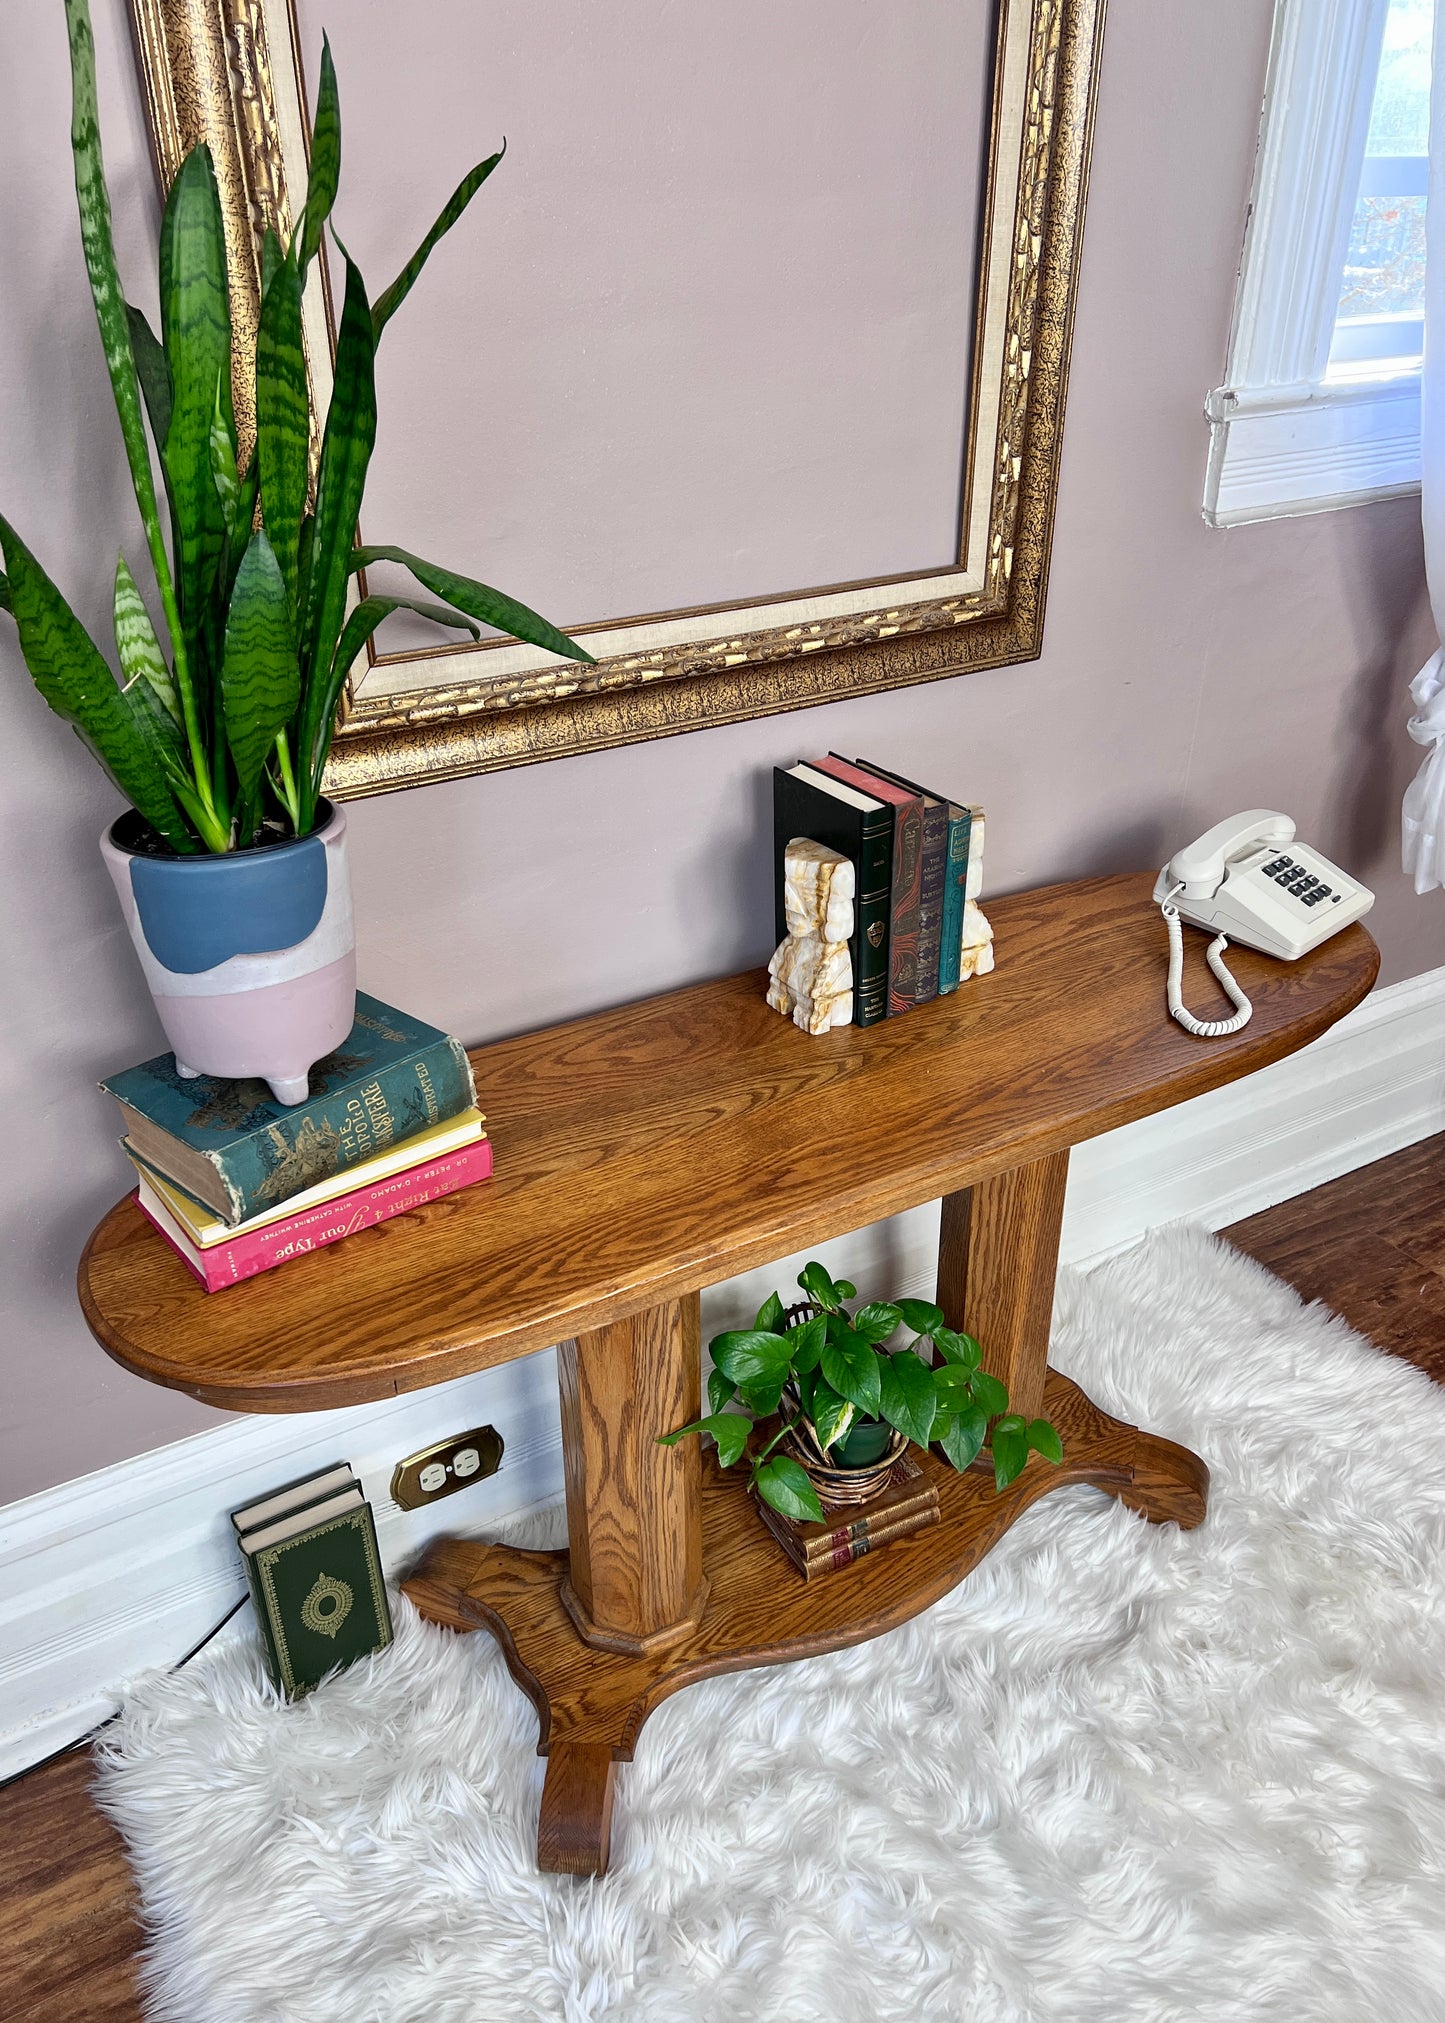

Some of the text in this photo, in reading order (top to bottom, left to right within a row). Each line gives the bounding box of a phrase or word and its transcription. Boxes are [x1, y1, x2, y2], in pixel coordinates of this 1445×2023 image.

[360, 1081, 395, 1152] HAKSPERE
[414, 1062, 439, 1126] USTRATED
[339, 1117, 357, 1163] THE
[347, 1099, 372, 1159] EOPOLD
[424, 1164, 451, 1179] PETER
[454, 1157, 468, 1167] DR.
[370, 1179, 411, 1200] D'ADAMO
[260, 1202, 353, 1242] WITH CATHERINE WHITNEY
[275, 1179, 461, 1259] Eat Right 4 Your Type
